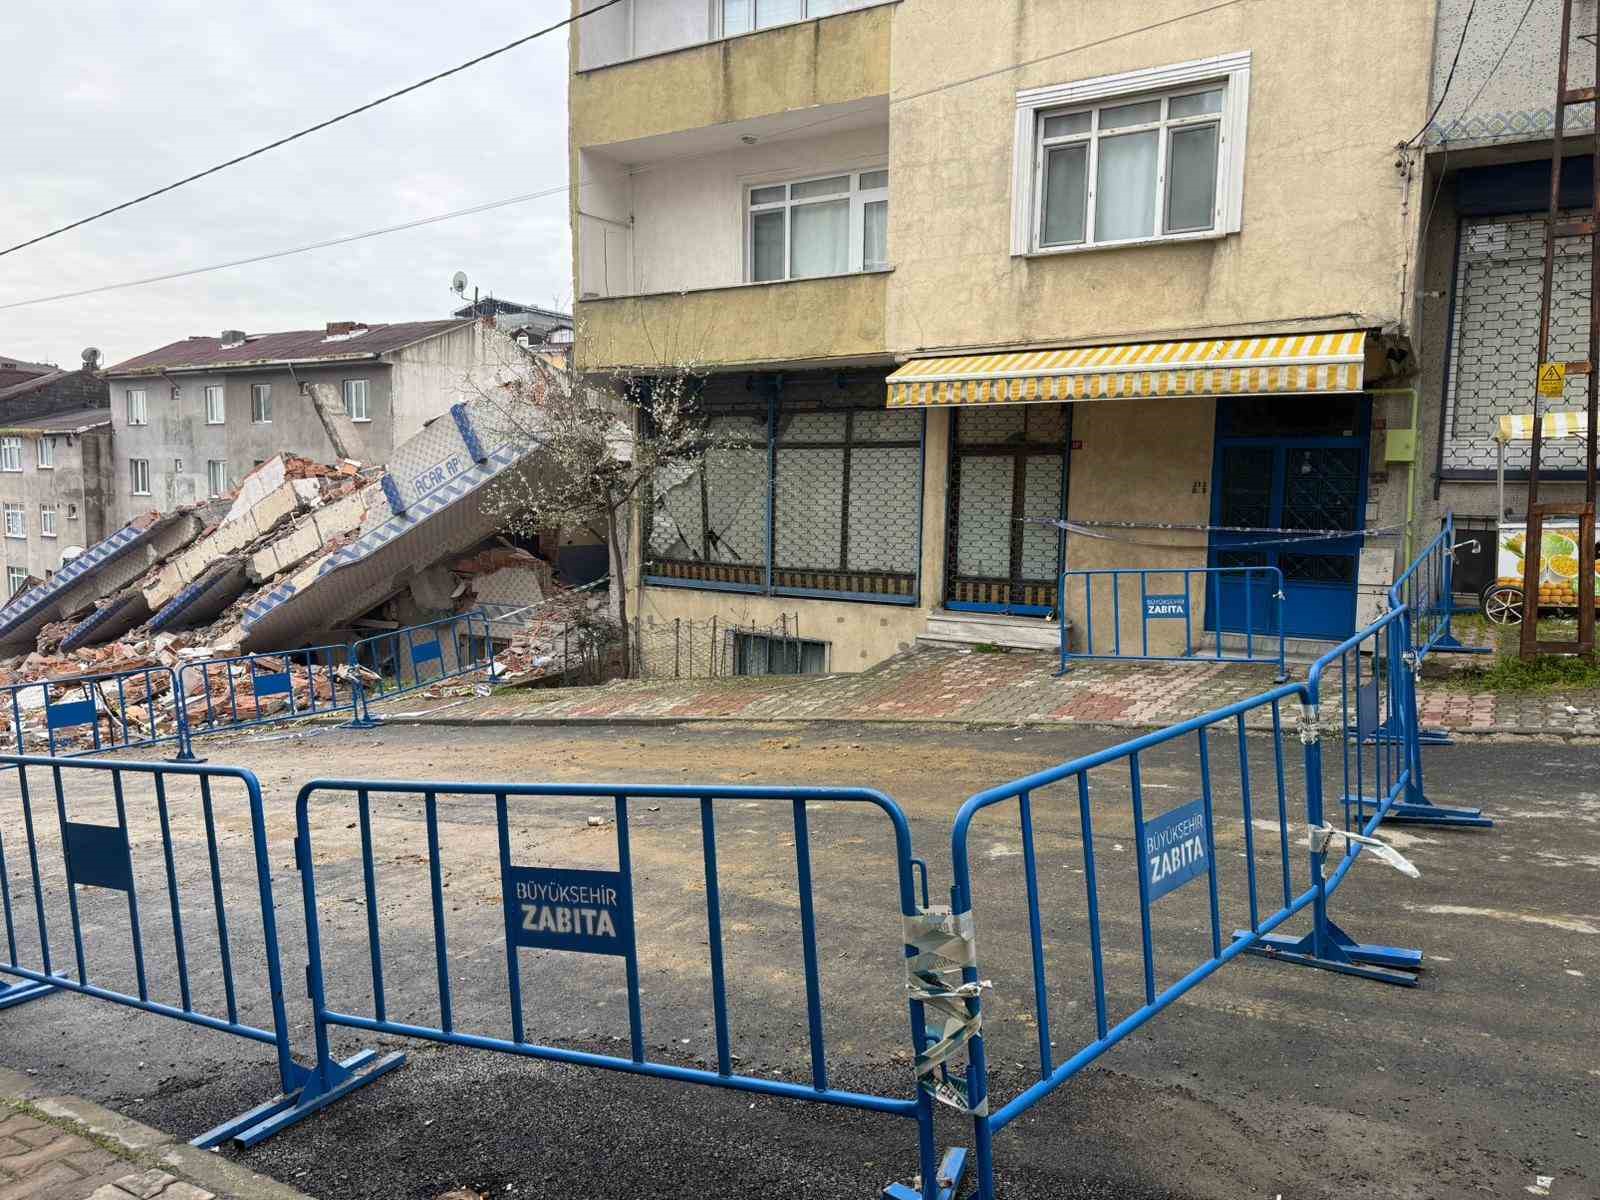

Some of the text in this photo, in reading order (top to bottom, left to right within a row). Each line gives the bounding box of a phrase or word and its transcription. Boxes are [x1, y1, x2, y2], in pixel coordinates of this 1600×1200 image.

[415, 465, 446, 496] ACAR
[1148, 605, 1184, 614] ZABITA
[1150, 835, 1204, 884] ZABITA
[516, 880, 617, 906] BÜYÜKŞEHİR
[521, 904, 617, 938] ZABITA
